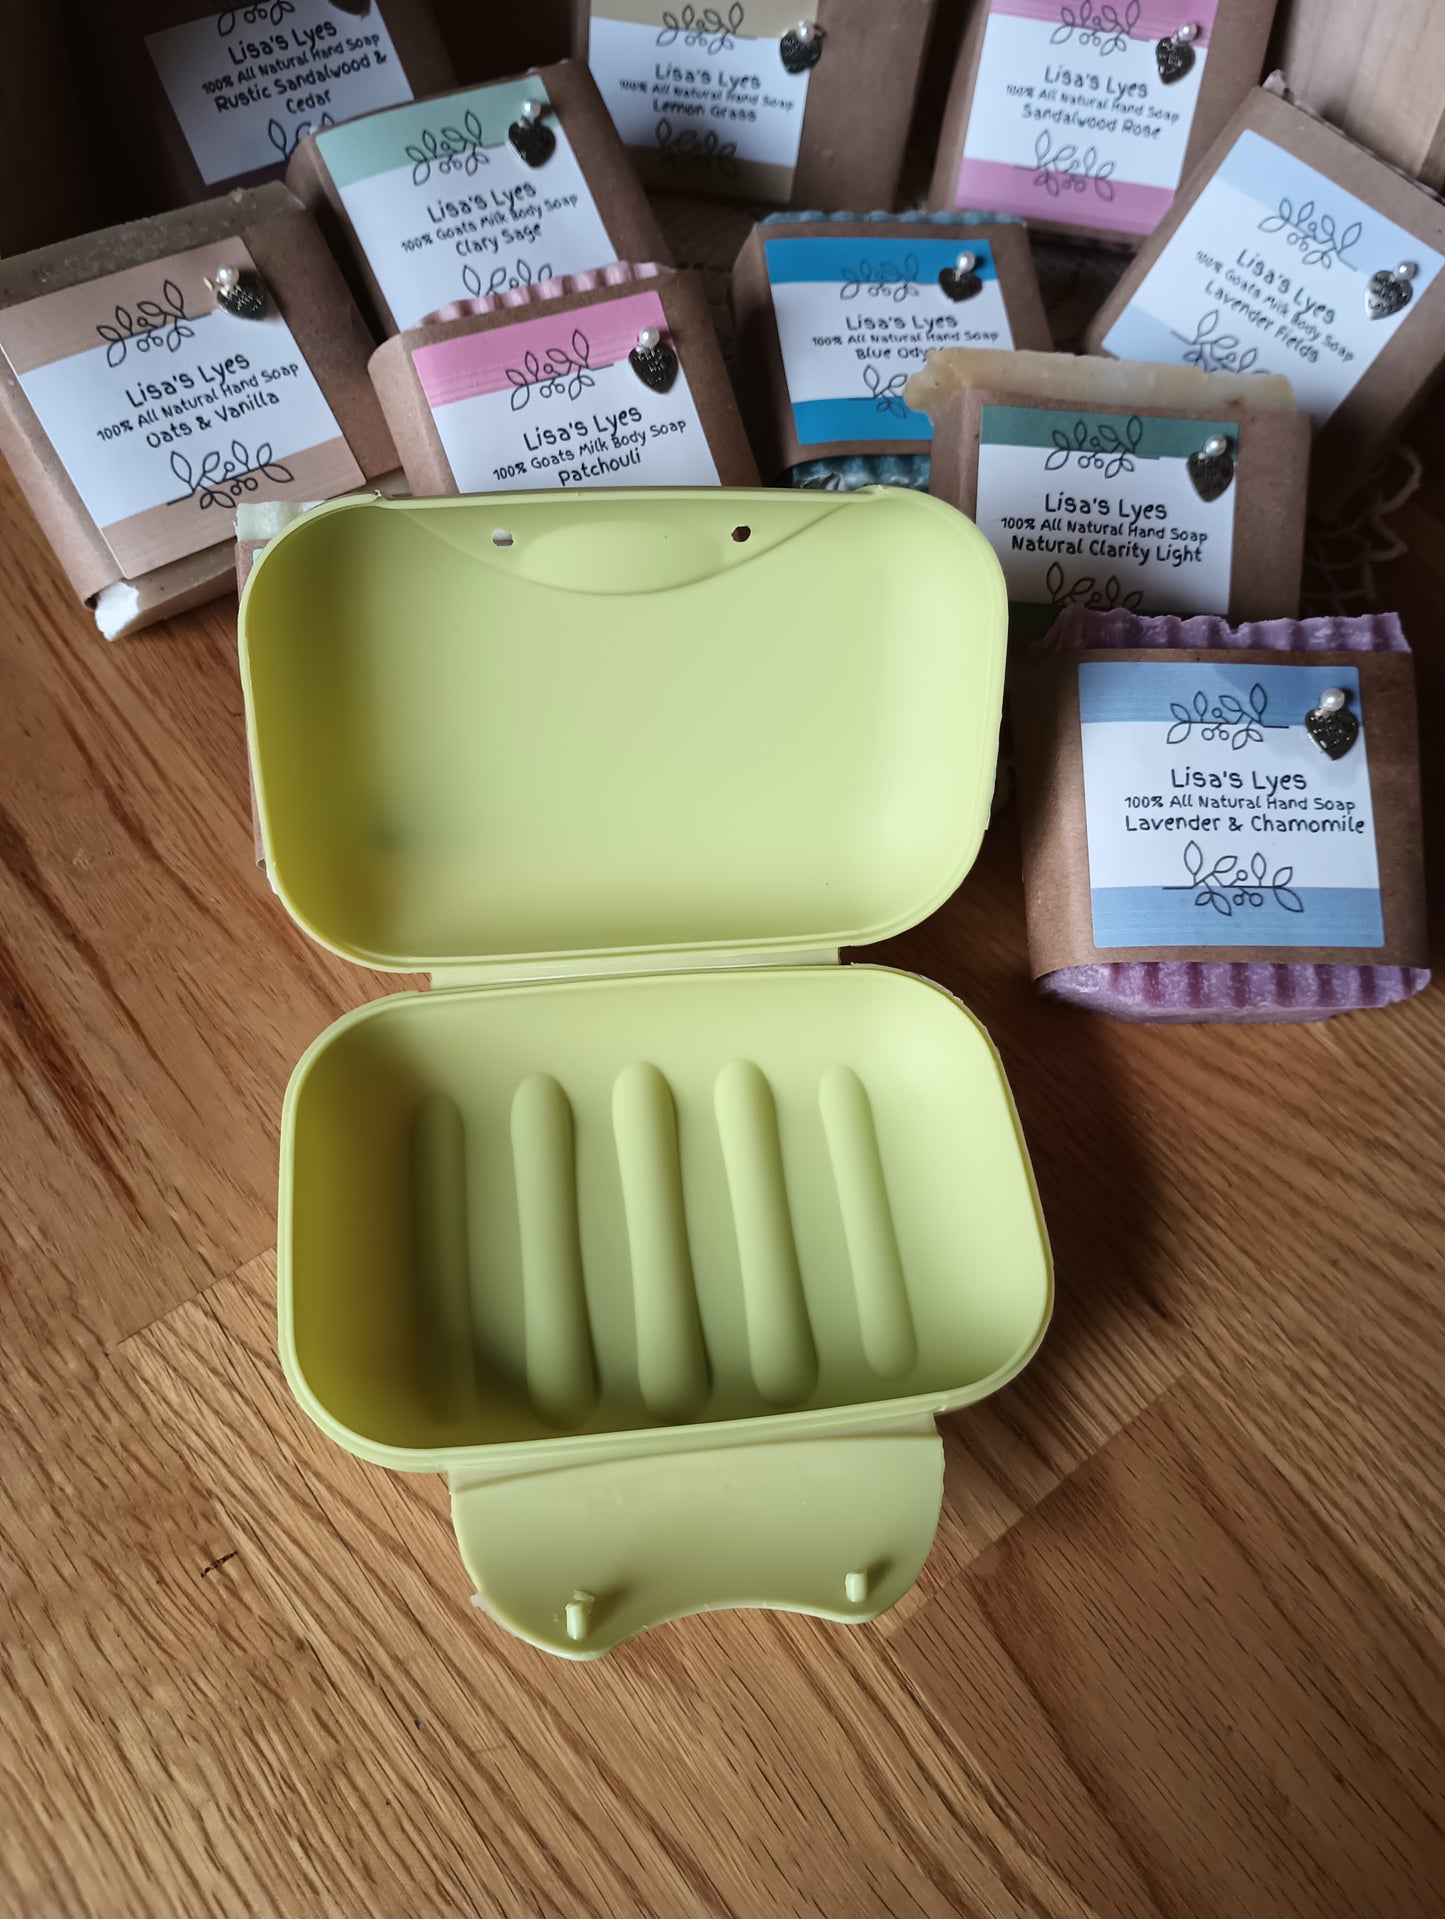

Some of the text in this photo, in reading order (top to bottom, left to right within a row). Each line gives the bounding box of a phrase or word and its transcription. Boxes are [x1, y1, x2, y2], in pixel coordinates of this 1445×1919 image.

[227, 21, 337, 65] Lisa's Lyes
[202, 34, 380, 95] 100% All Natural Hand Soap
[214, 51, 388, 113] Rustic Sandalwood &
[655, 63, 761, 92] Lisa's Lyes
[1044, 66, 1148, 100] Lisa's Lyes
[285, 90, 333, 114] Cedar
[652, 84, 669, 96] All
[674, 86, 722, 100] Natural
[726, 91, 759, 106] Hand
[762, 95, 794, 113] Soap
[653, 99, 757, 123] Lemon Grass
[1006, 85, 1180, 125] 100% All Natural Hand Soap
[1021, 103, 1161, 140] Sandalwood Rose
[427, 182, 537, 224] Lisa's Lyes
[400, 193, 578, 253] 100% Goats Milk Body Soap
[456, 222, 543, 257] Clary Sage
[1236, 248, 1291, 294] Lisa's
[1293, 287, 1335, 325] Lyes
[845, 314, 958, 334] Lisa's Lyes
[1204, 280, 1320, 364] Lavender Fields
[1225, 270, 1261, 299] Goats
[1263, 295, 1289, 318] Milk
[1290, 312, 1320, 342] Body
[1321, 335, 1355, 363] Soap
[811, 331, 999, 347] 100% All Natural Hand Soap
[855, 347, 892, 361] Blue
[125, 353, 250, 408] Lisa's Lyes
[97, 363, 299, 442] 100% All Natural Hand Soap
[146, 392, 280, 449] Oats & Vanilla
[523, 407, 642, 451] Lisa's Lyes
[493, 419, 687, 480] 100% Goats Milk Body Soap
[558, 447, 641, 486] Patchouli
[1045, 491, 1167, 524] Lisa's Lyes
[1000, 517, 1208, 543] 100% All Natural Hand Soap
[1011, 535, 1202, 567] Natural Clarity Light
[1170, 766, 1307, 797] Lisa's Lyes
[1124, 794, 1356, 814] 100% All Natural Hand Soap
[1125, 813, 1365, 833] Lavender & Chamomile
